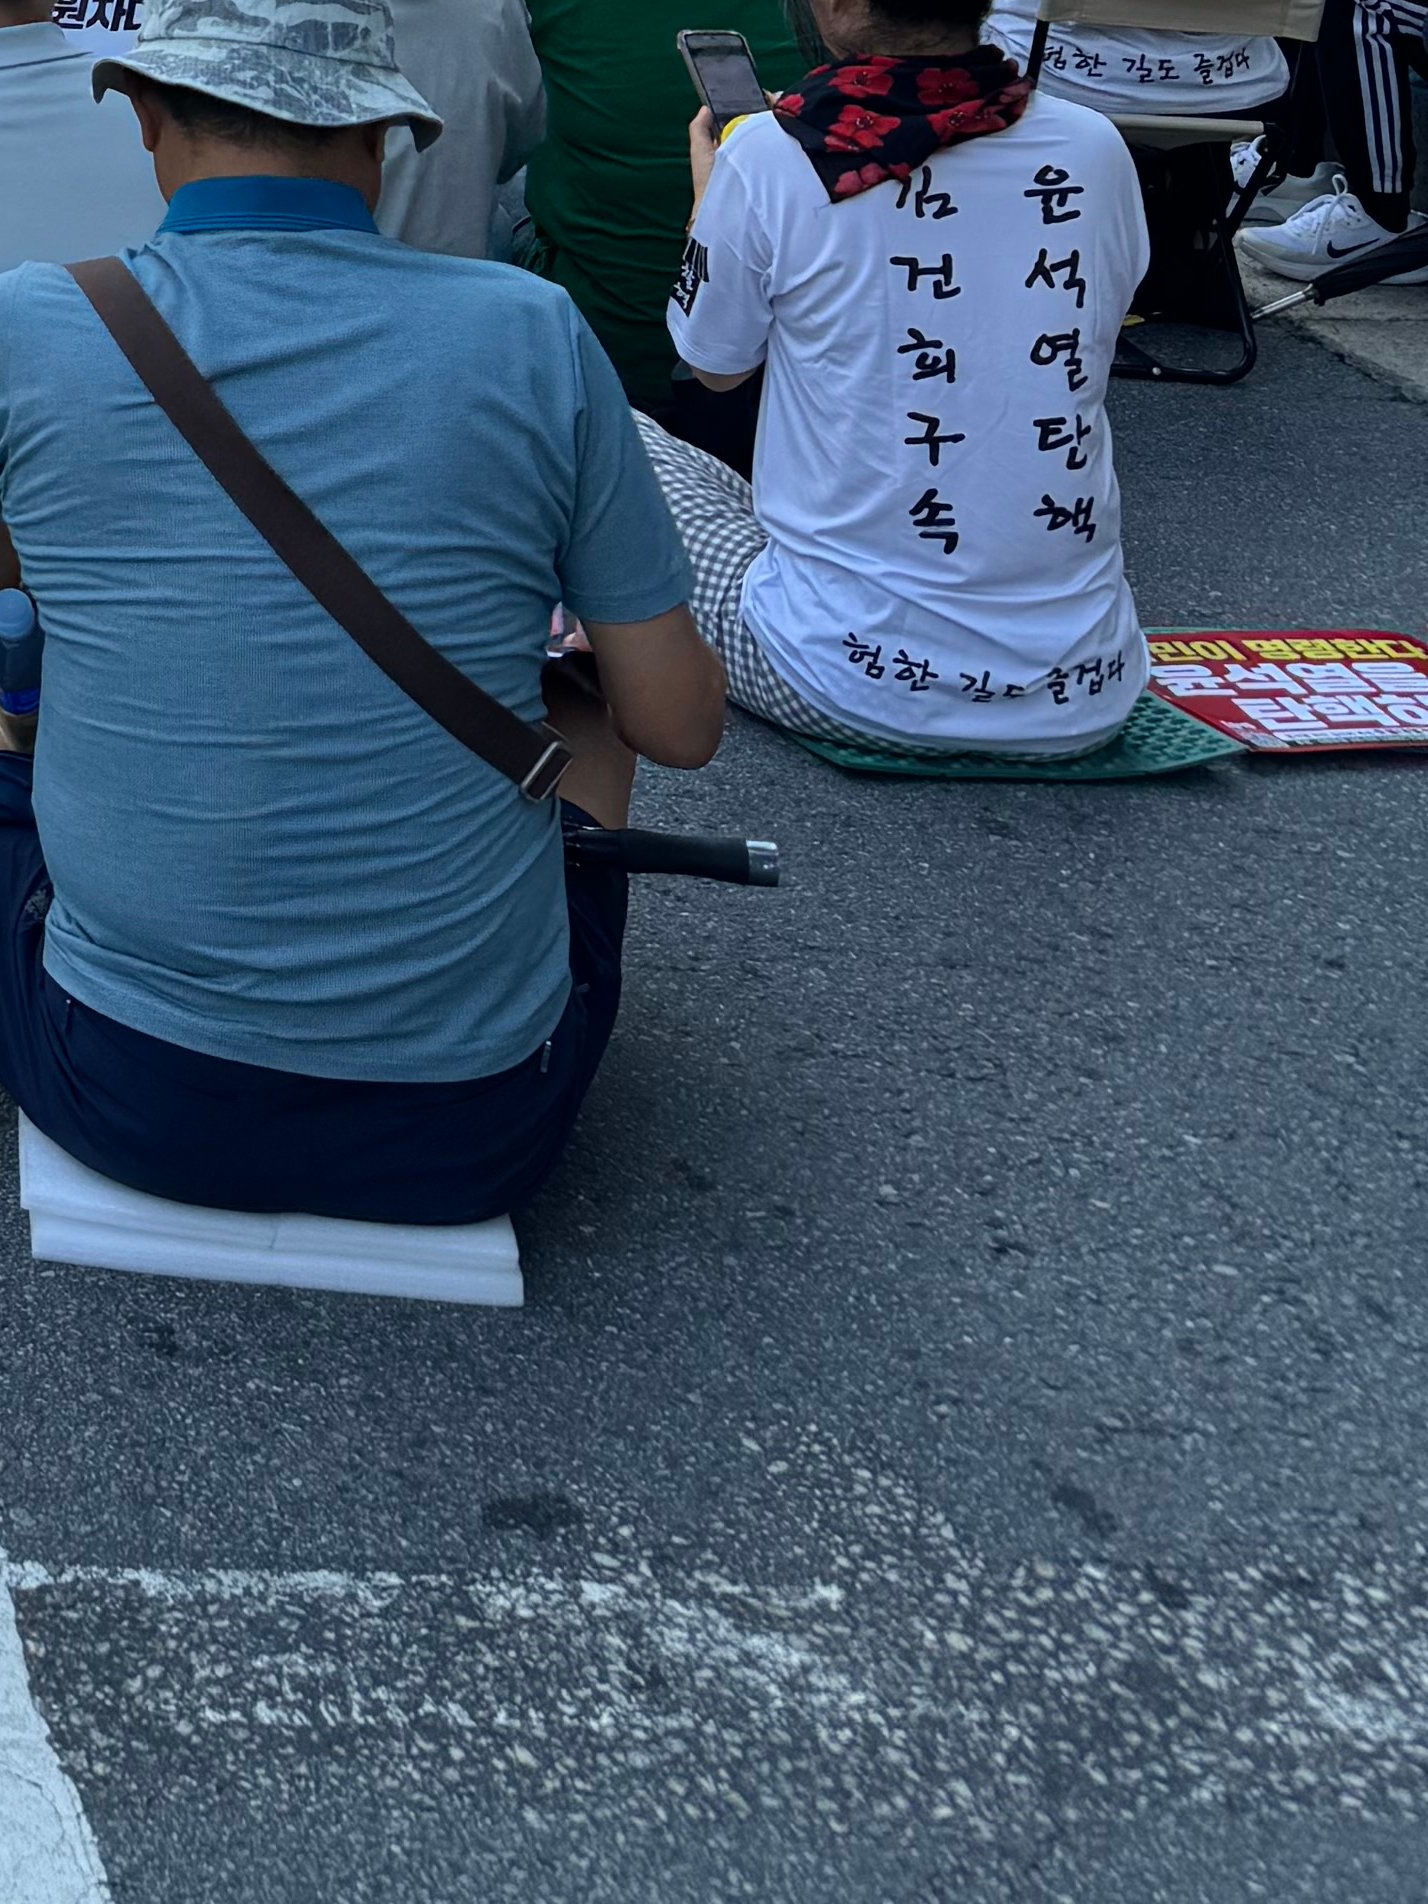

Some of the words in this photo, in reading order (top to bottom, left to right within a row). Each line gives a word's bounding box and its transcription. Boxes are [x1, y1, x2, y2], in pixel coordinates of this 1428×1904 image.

[1122, 54, 1179, 84] 길도
[842, 631, 939, 692] 험한
[1147, 638, 1247, 662] 민이
[1241, 637, 1428, 661] 명령한다
[1150, 660, 1428, 696] 윤석열을
